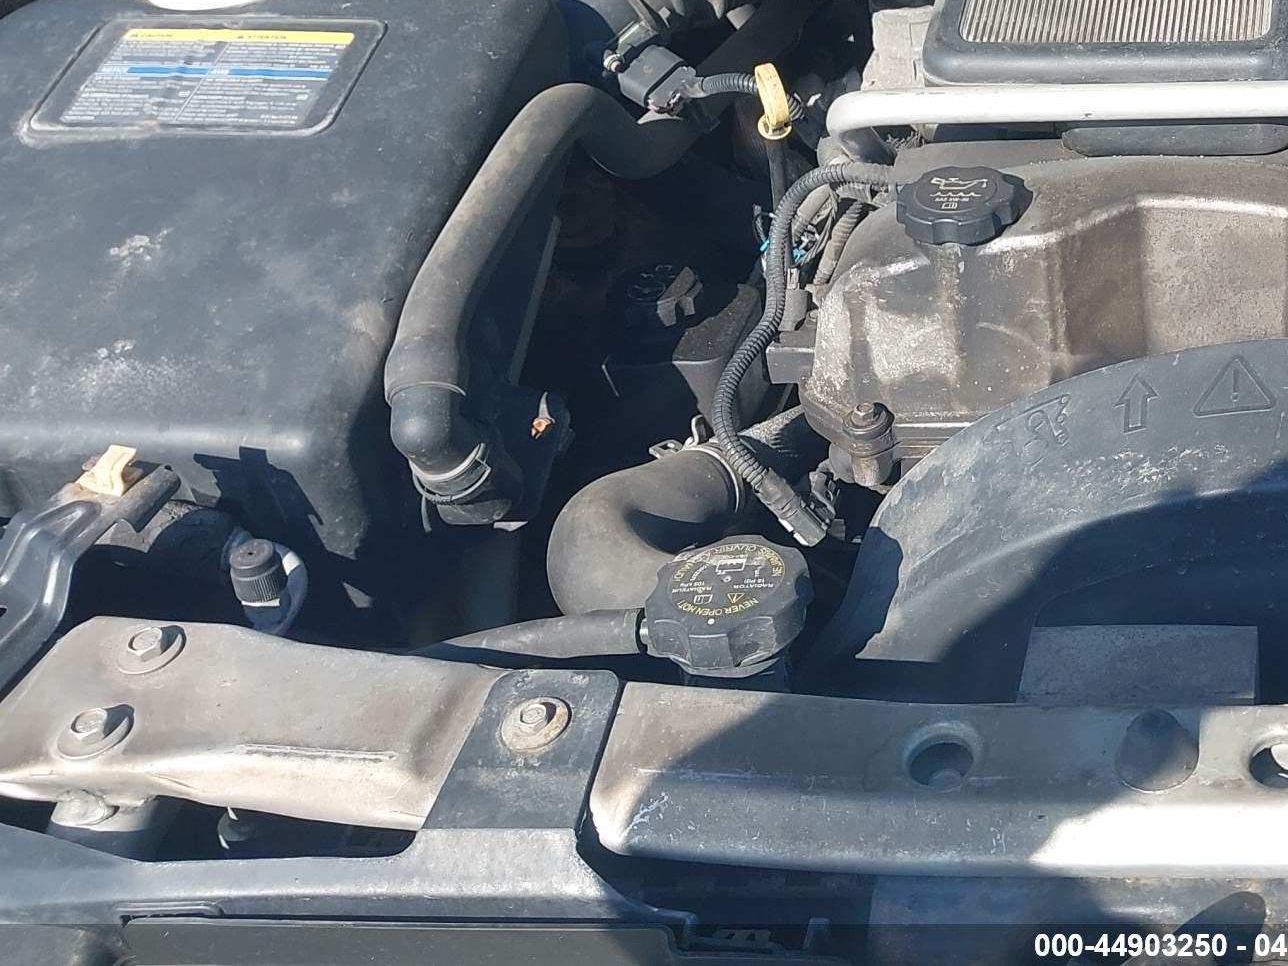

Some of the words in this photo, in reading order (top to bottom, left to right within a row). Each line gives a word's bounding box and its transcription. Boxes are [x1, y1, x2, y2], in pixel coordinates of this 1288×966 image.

[714, 544, 757, 554] OUVRIR
[676, 599, 697, 614] HOT!
[694, 604, 723, 617] OPEN
[724, 596, 760, 614] NEVER
